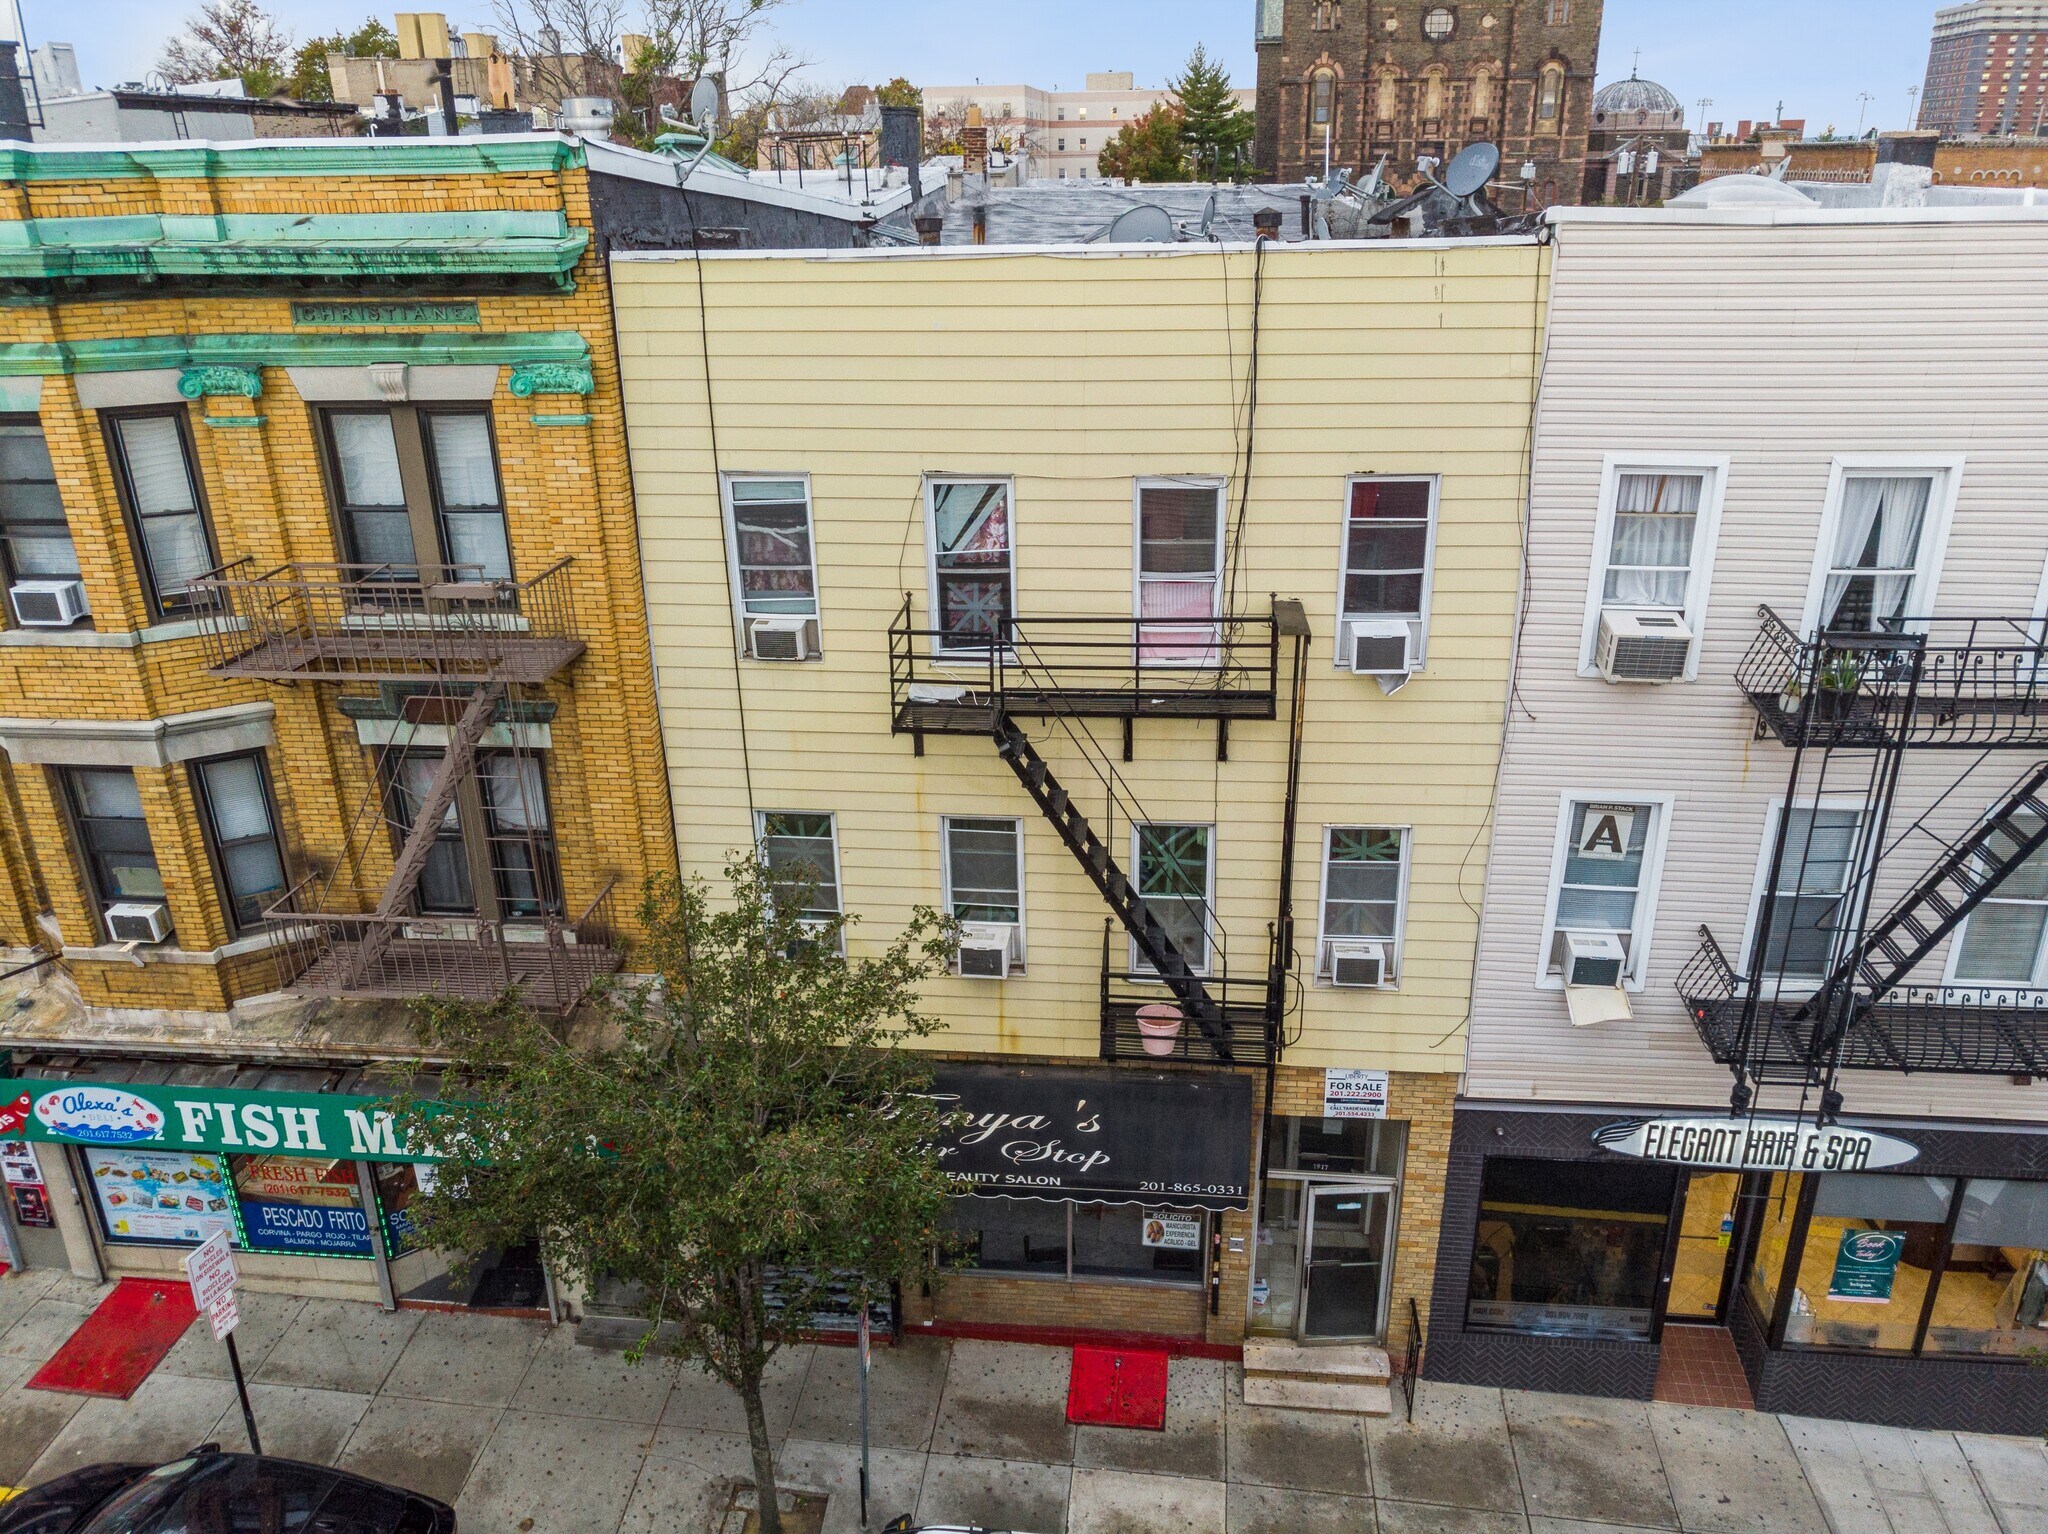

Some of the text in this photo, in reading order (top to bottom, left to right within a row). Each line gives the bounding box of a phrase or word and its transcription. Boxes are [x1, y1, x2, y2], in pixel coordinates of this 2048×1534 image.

[1583, 815, 1623, 853] A
[1330, 1082, 1382, 1091] FOR SALE
[1330, 1090, 1382, 1098] 201.222.2900
[89, 1114, 114, 1122] DELI
[174, 1100, 327, 1150] FISH
[78, 1129, 133, 1140] 201.617.7532
[1644, 1124, 1872, 1171] ELEGANT HAIR & SPA
[1001, 1139, 1110, 1172] Stop
[250, 1165, 355, 1185] FRESH FISH
[940, 1171, 1062, 1186] EAUTY SALON
[1139, 1181, 1243, 1196] 201-865-0331
[262, 1207, 366, 1231] PESCADO FRITO
[1153, 1213, 1192, 1222] SOLICITO
[1165, 1222, 1197, 1231] MANICURISTA
[258, 1228, 291, 1237] CORVINA
[296, 1231, 322, 1239] PARGO
[325, 1232, 346, 1240] ROJO
[1165, 1230, 1196, 1239] EXPERIENCIA
[284, 1237, 357, 1248] SALMON MOJARRA
[1856, 1238, 1886, 1249] Book
[203, 1245, 215, 1258] NO
[1855, 1249, 1885, 1260] Today!
[198, 1247, 223, 1270] BICYCLES
[195, 1251, 230, 1283] ON SIDEWALK
[209, 1269, 220, 1281] NO
[202, 1269, 231, 1296] BICICLETAS
[202, 1276, 234, 1305] EN LA ACERA
[216, 1295, 227, 1308] NO
[211, 1299, 235, 1321] PARKING
